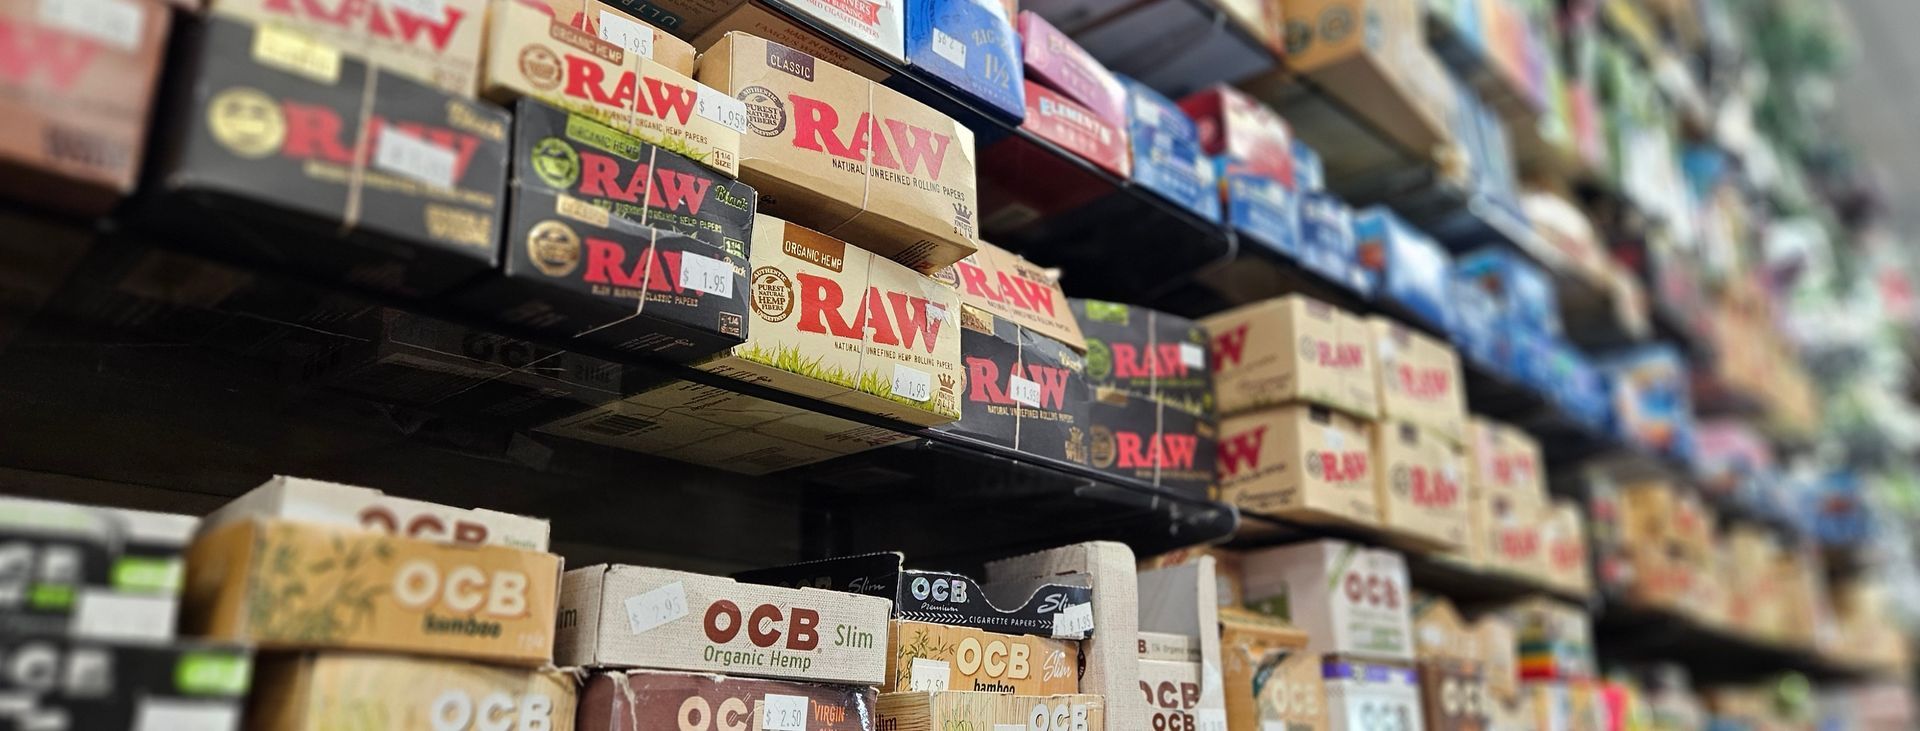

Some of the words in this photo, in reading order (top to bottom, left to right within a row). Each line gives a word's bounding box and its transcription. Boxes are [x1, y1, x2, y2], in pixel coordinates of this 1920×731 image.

[553, 25, 594, 52] ORGANIC
[595, 43, 622, 63] HEMP
[621, 32, 647, 56] 1.95
[770, 54, 811, 79] CLASSIC
[563, 54, 698, 126] RAW
[745, 103, 777, 115] PUREST
[635, 117, 663, 132] ORGANIC
[665, 126, 682, 137] HEMP
[684, 130, 708, 145] PAPERS
[788, 91, 951, 181] RAW
[613, 140, 640, 157] HEMP
[714, 159, 732, 170] SIZE
[578, 151, 713, 216] RAW
[832, 159, 865, 176] NATURAL
[869, 167, 911, 186] UNREFINED
[913, 178, 941, 194] ROLLING
[943, 186, 965, 202] PAPERS
[647, 209, 677, 224] ORGANIC
[700, 220, 722, 233] PAPERS
[785, 239, 820, 263] ORGANIC
[821, 249, 842, 270] HEMP
[703, 272, 725, 294] 1.95
[758, 284, 784, 293] PUREST
[758, 290, 785, 298] NATURAL
[956, 260, 1056, 318] RAW
[645, 291, 673, 305] CLASSIC
[675, 296, 699, 308] PAPERS
[758, 296, 786, 306] HEMP
[796, 272, 947, 354] RAW
[834, 341, 861, 354] NATURAL
[866, 347, 896, 359] UNREFINED
[898, 352, 912, 361] HEMP
[914, 355, 935, 367] ROLLING
[936, 360, 954, 371] PAPERS
[909, 381, 926, 399] 1.95
[988, 404, 1009, 417] NATURAL
[1115, 431, 1197, 469] RAW
[393, 560, 528, 616] OCB
[911, 576, 969, 604] OCB
[920, 602, 960, 612] Premium
[703, 599, 822, 652] OCB
[834, 623, 874, 650] Slim
[968, 615, 1008, 626] CIGARETTE
[1010, 618, 1037, 628] PAPERS
[703, 645, 764, 667] Organic
[770, 650, 813, 673] Hemp
[956, 637, 1031, 681] OCB
[432, 690, 553, 731] OCB
[780, 710, 803, 728] 2.50
[811, 700, 846, 726] VIRGIN
[1029, 703, 1089, 731] OCB
[1152, 712, 1196, 731] OCB
